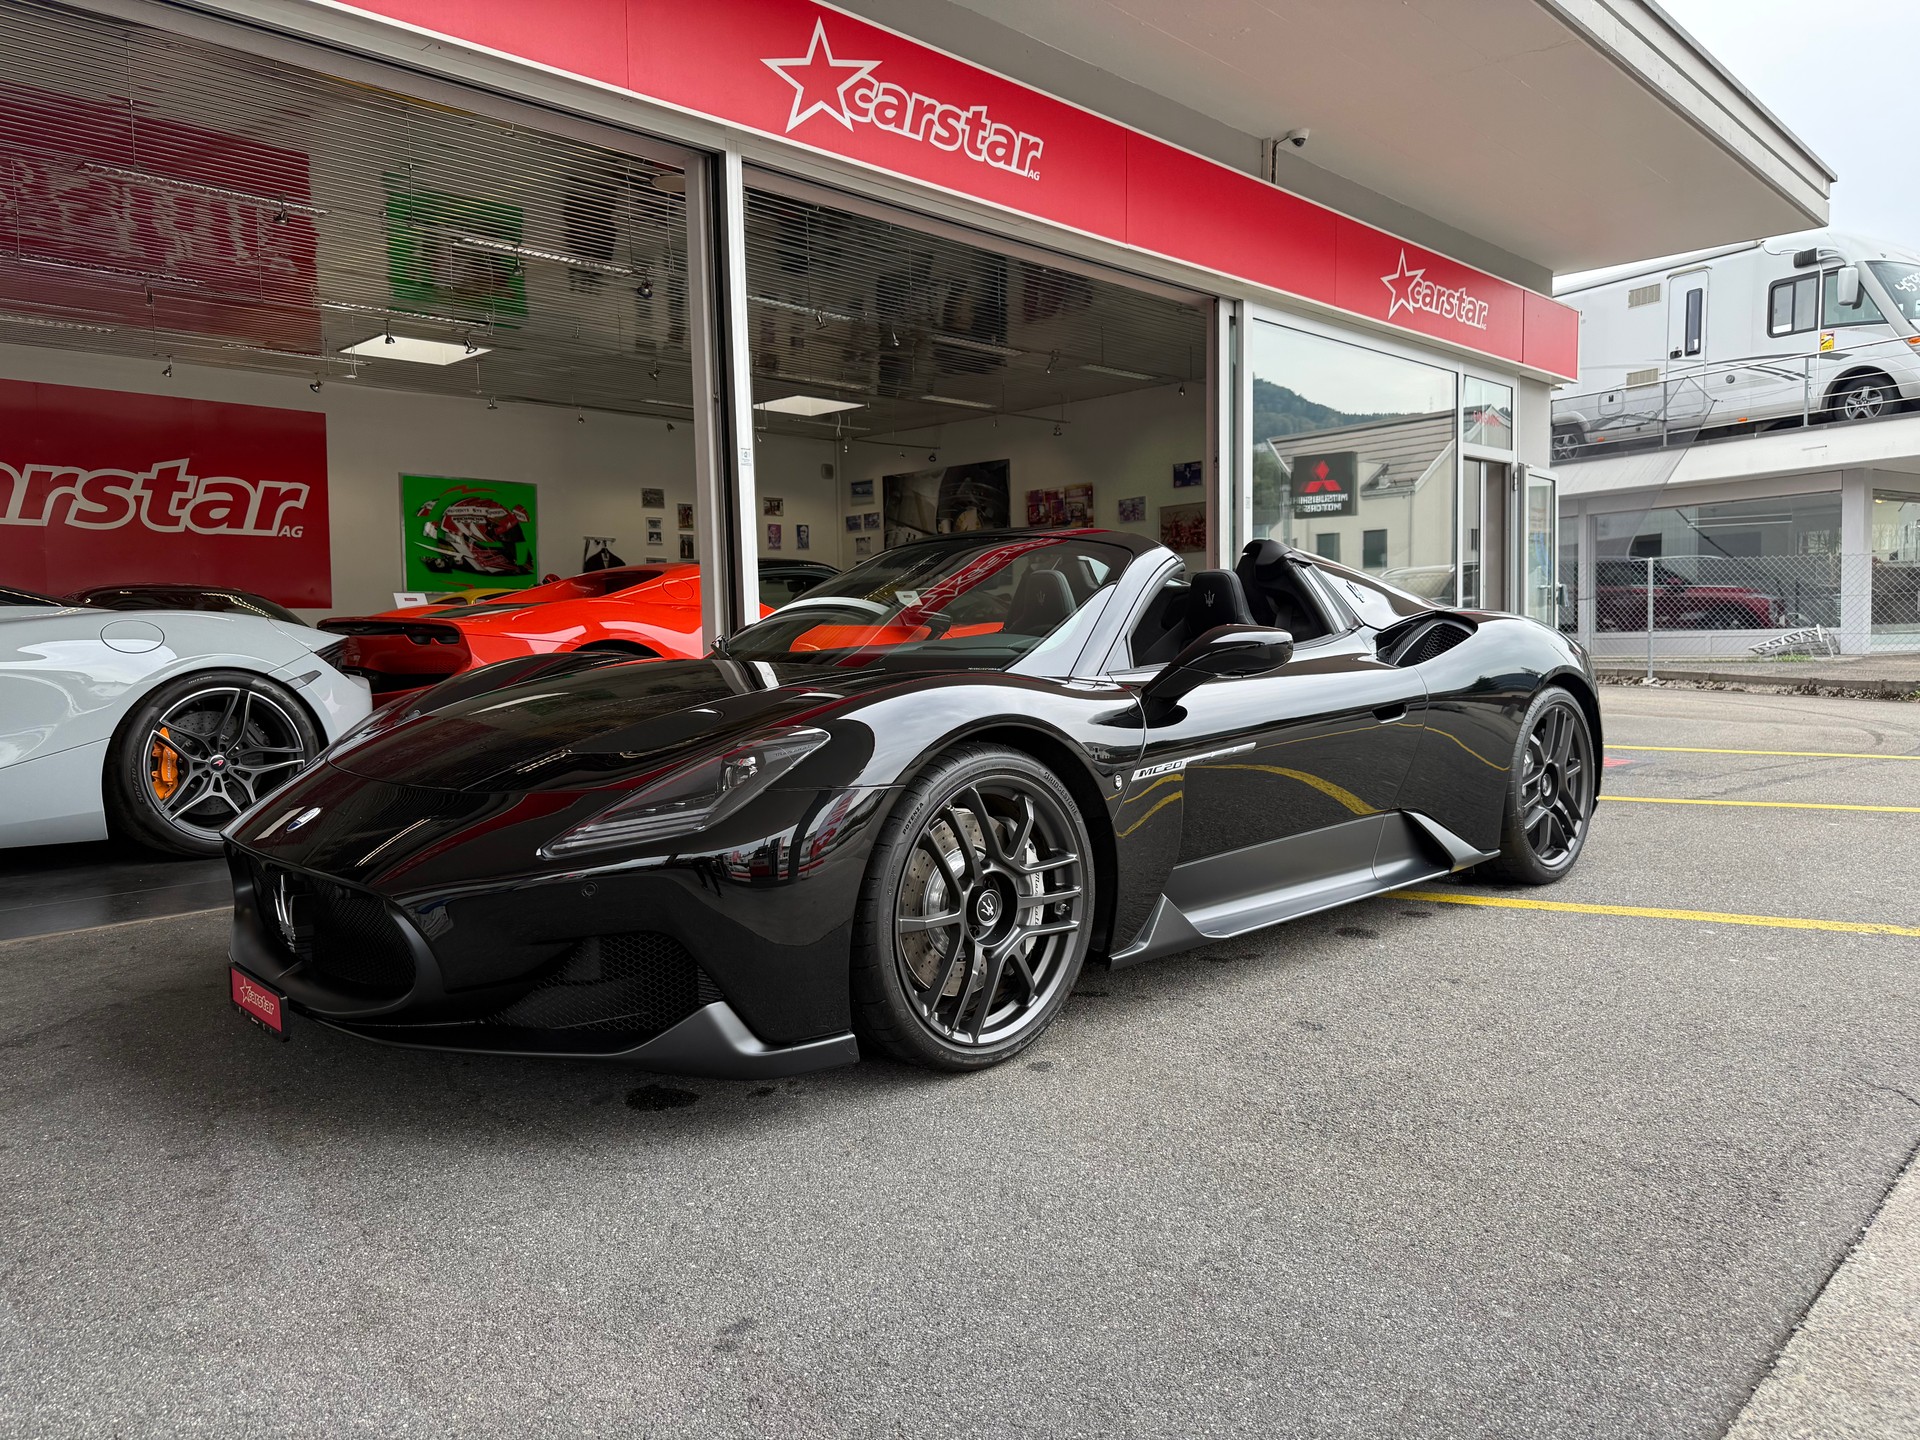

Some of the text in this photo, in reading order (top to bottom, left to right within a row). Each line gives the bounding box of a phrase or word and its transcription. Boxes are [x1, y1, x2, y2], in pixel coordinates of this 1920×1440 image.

[842, 75, 1044, 181] carstar AG
[1408, 277, 1489, 329] carstar
[278, 525, 303, 538] AG
[1138, 760, 1183, 777] MC20
[1044, 771, 1078, 815] BRIDGESTONE
[902, 802, 924, 835] POTENZA
